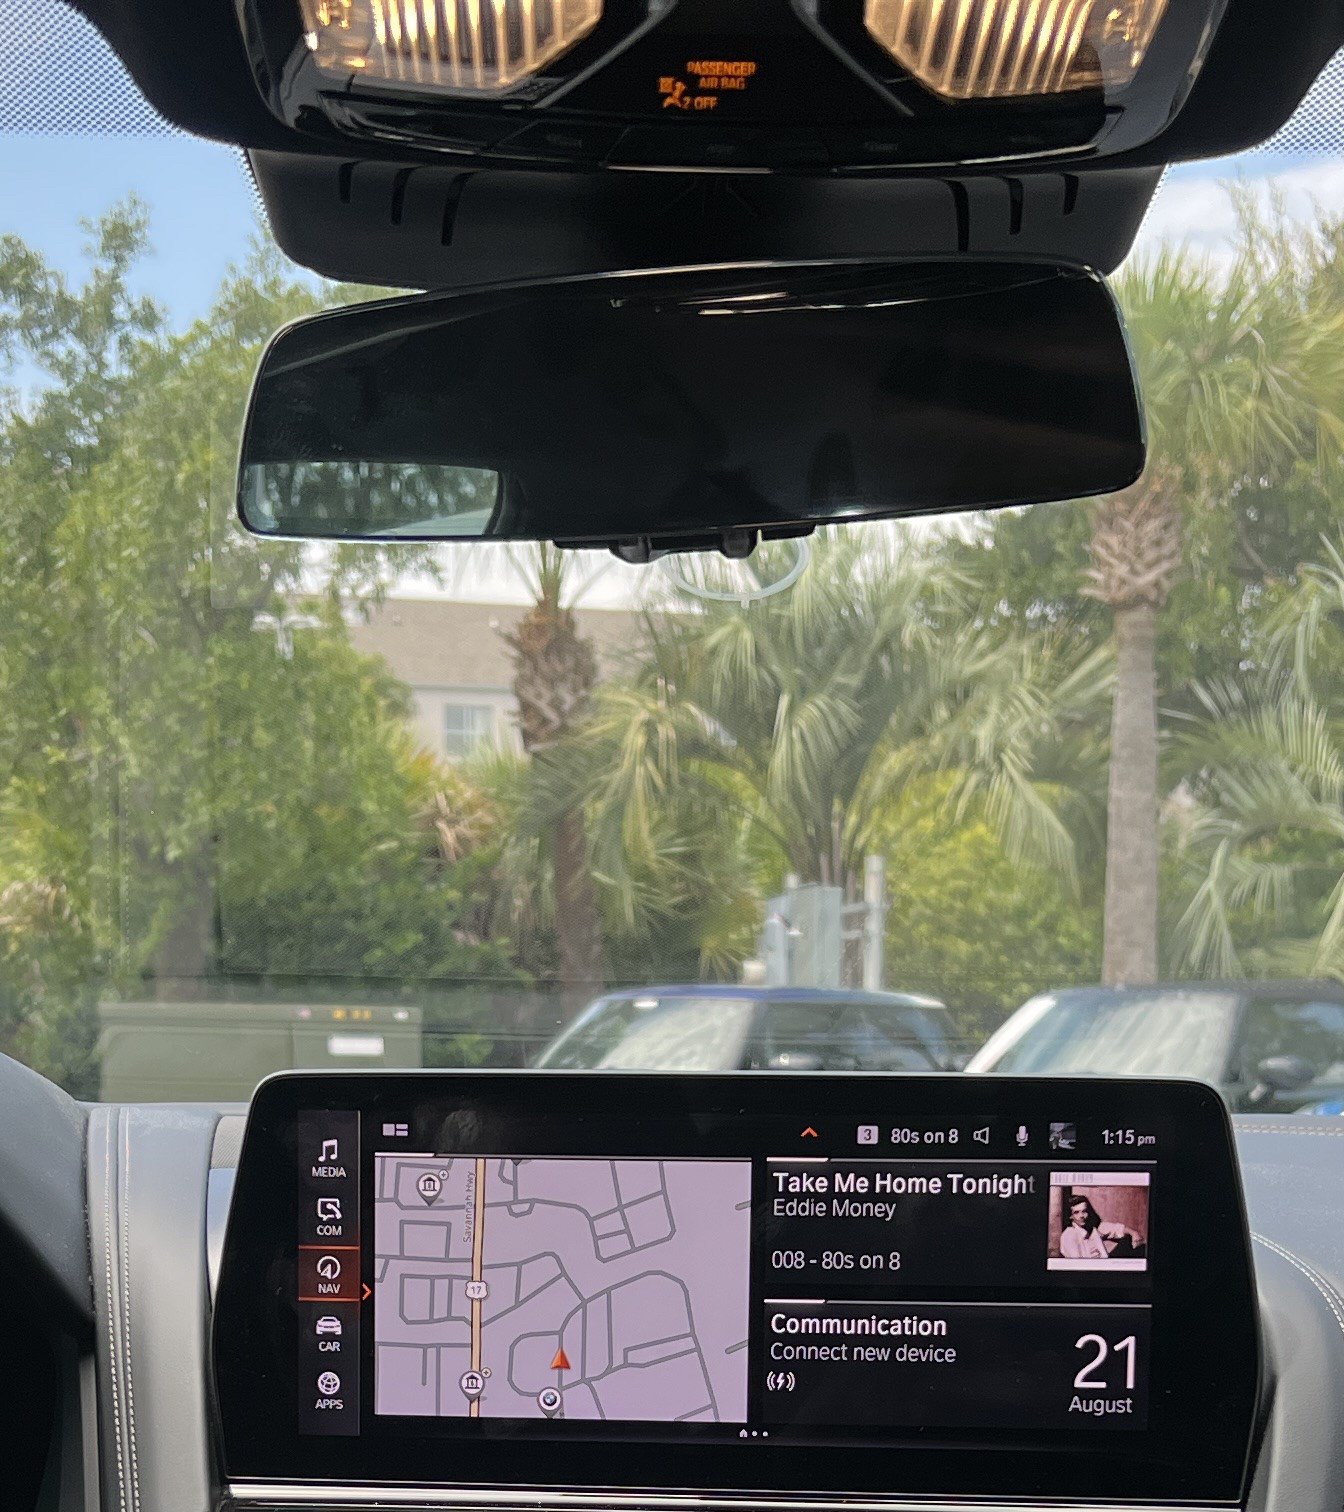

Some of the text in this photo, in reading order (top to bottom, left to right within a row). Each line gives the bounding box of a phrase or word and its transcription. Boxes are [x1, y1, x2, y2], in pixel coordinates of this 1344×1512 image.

[687, 61, 756, 76] PASSENGER
[890, 1128, 959, 1144] 80s on 8
[1101, 1129, 1156, 1147] 1:15 pm
[311, 1165, 346, 1179] MEDIA
[772, 1172, 828, 1194] Take
[834, 1173, 869, 1194] Me
[874, 1173, 942, 1195] Home
[772, 1198, 897, 1221] Eddie Money
[462, 1195, 474, 1243] Savannah
[316, 1224, 342, 1237] COM
[771, 1251, 805, 1269] 008
[821, 1251, 854, 1269] 80s
[859, 1255, 884, 1270] on
[889, 1252, 901, 1270] 8
[317, 1283, 341, 1295] NAV
[470, 1285, 483, 1296] 17
[771, 1313, 947, 1337] Communication
[318, 1340, 341, 1353] CAR
[770, 1342, 957, 1363] Connect new device
[1072, 1333, 1137, 1390] 21
[315, 1398, 343, 1412] APPS
[1068, 1396, 1133, 1417] August
